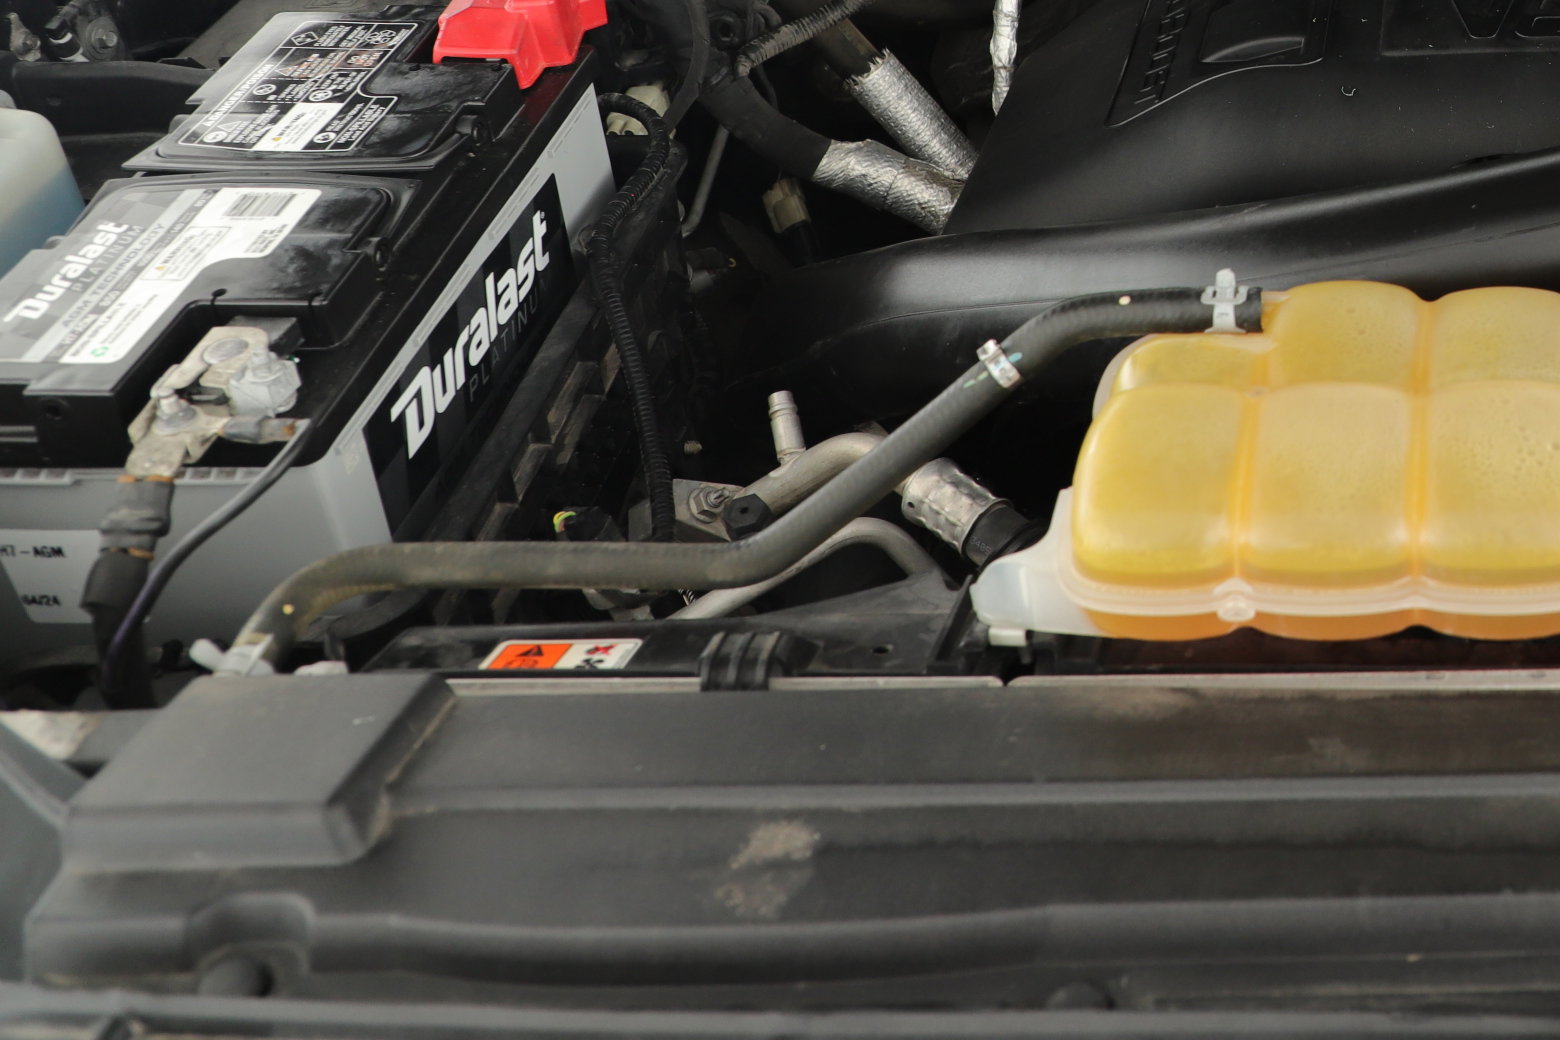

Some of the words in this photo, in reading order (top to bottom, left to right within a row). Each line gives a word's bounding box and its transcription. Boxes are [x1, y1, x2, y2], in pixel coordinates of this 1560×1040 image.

[3, 220, 129, 322] Duralast
[72, 225, 144, 292] PLATINUM
[391, 210, 549, 460] Duralast
